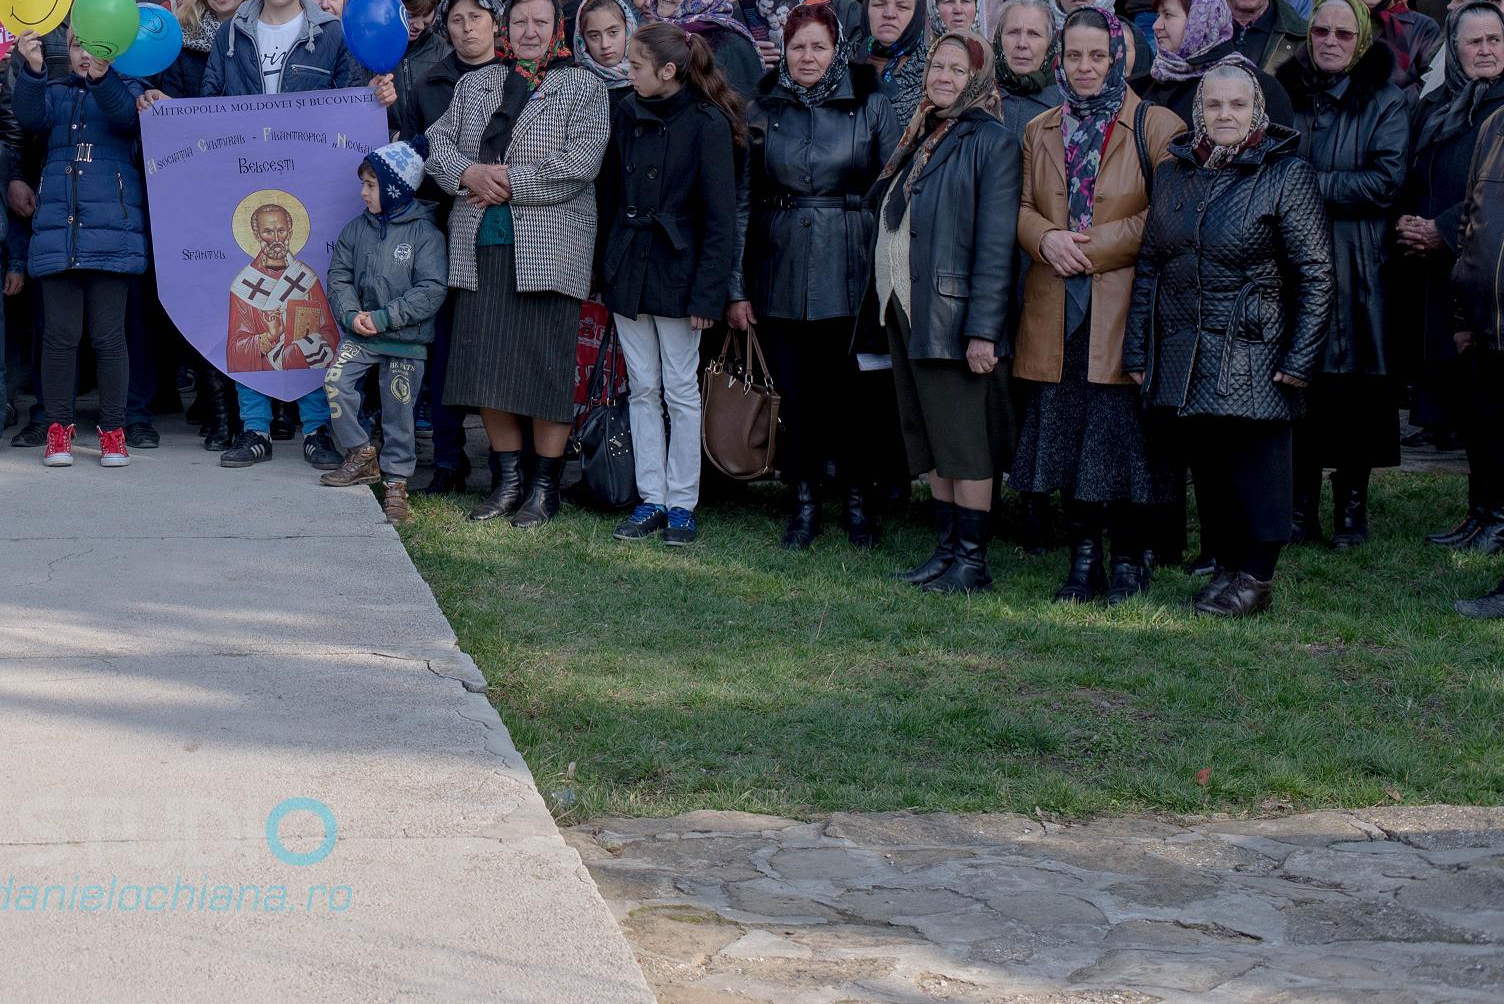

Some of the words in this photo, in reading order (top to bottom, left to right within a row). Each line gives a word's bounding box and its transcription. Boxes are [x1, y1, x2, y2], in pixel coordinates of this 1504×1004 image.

[152, 105, 227, 116] MITROPOLIA
[231, 99, 292, 112] MOLDOVEI
[310, 94, 374, 106] BUCOVINEI
